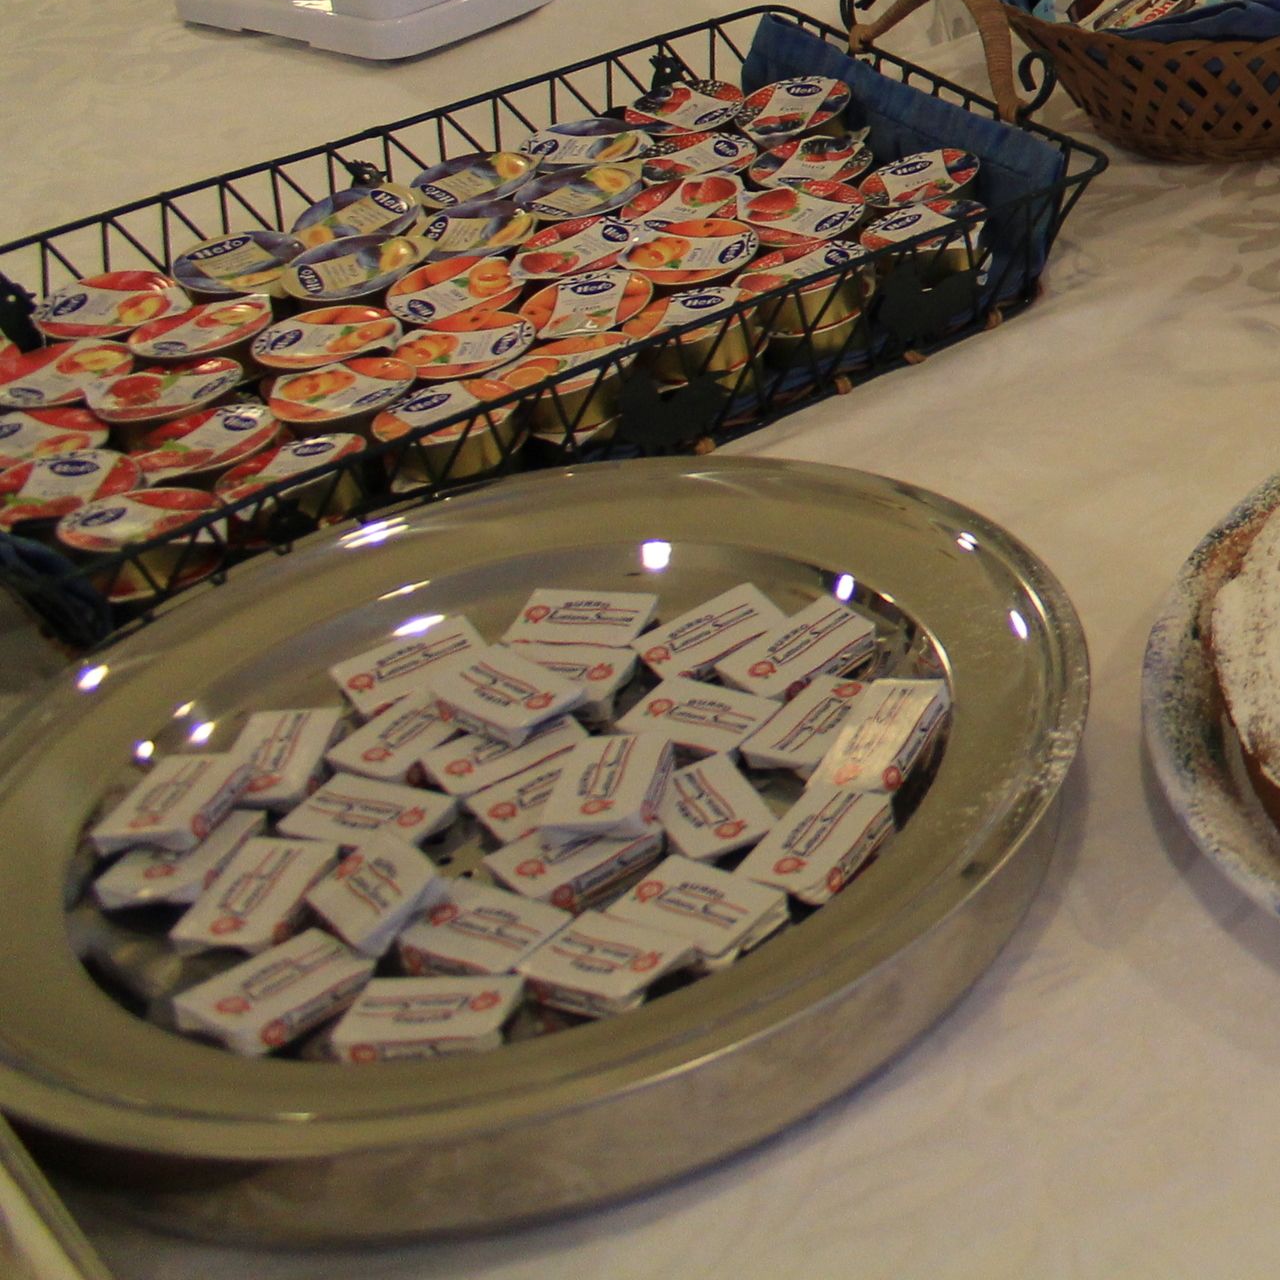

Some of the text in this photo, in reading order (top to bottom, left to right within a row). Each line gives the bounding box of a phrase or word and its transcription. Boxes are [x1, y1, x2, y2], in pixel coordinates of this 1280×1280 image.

[789, 84, 820, 96] Hero
[375, 192, 407, 214] Hero
[424, 186, 457, 206] Hero
[427, 220, 446, 241] ero
[195, 238, 244, 259] Hero
[299, 266, 323, 293] Hero
[574, 280, 614, 295] Hero
[685, 296, 721, 309] Hero
